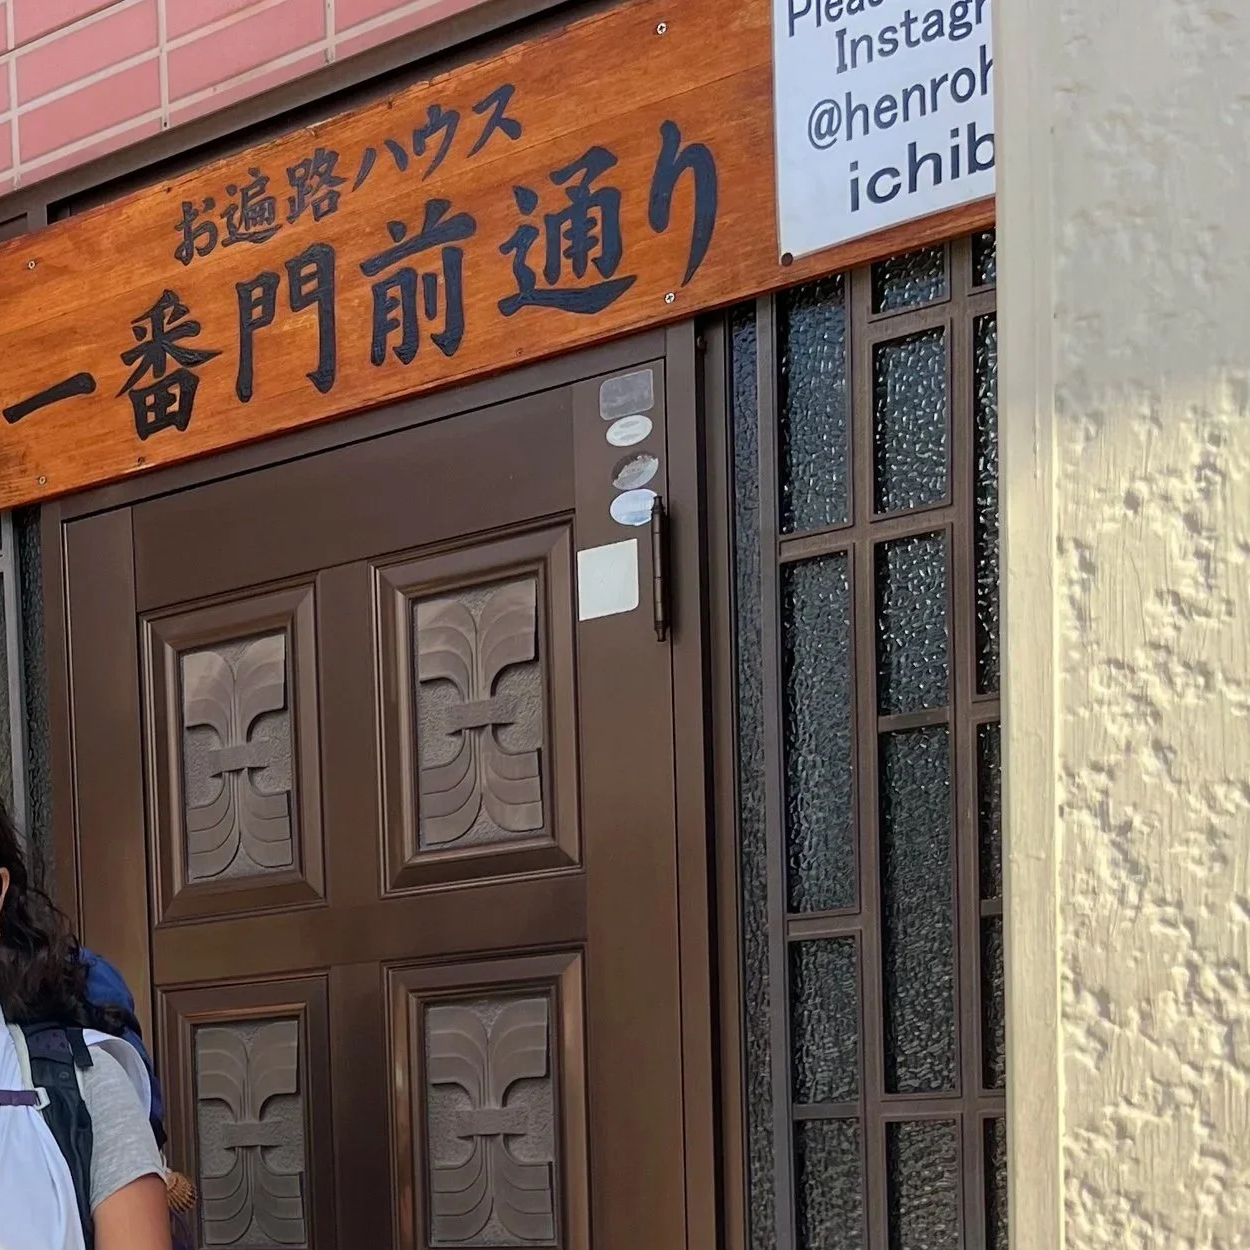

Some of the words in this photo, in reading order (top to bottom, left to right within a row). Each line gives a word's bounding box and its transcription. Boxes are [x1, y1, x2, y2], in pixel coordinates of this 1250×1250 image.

[2, 119, 719, 442] 一番門前通り
[173, 84, 523, 266] お遍路ハウス
